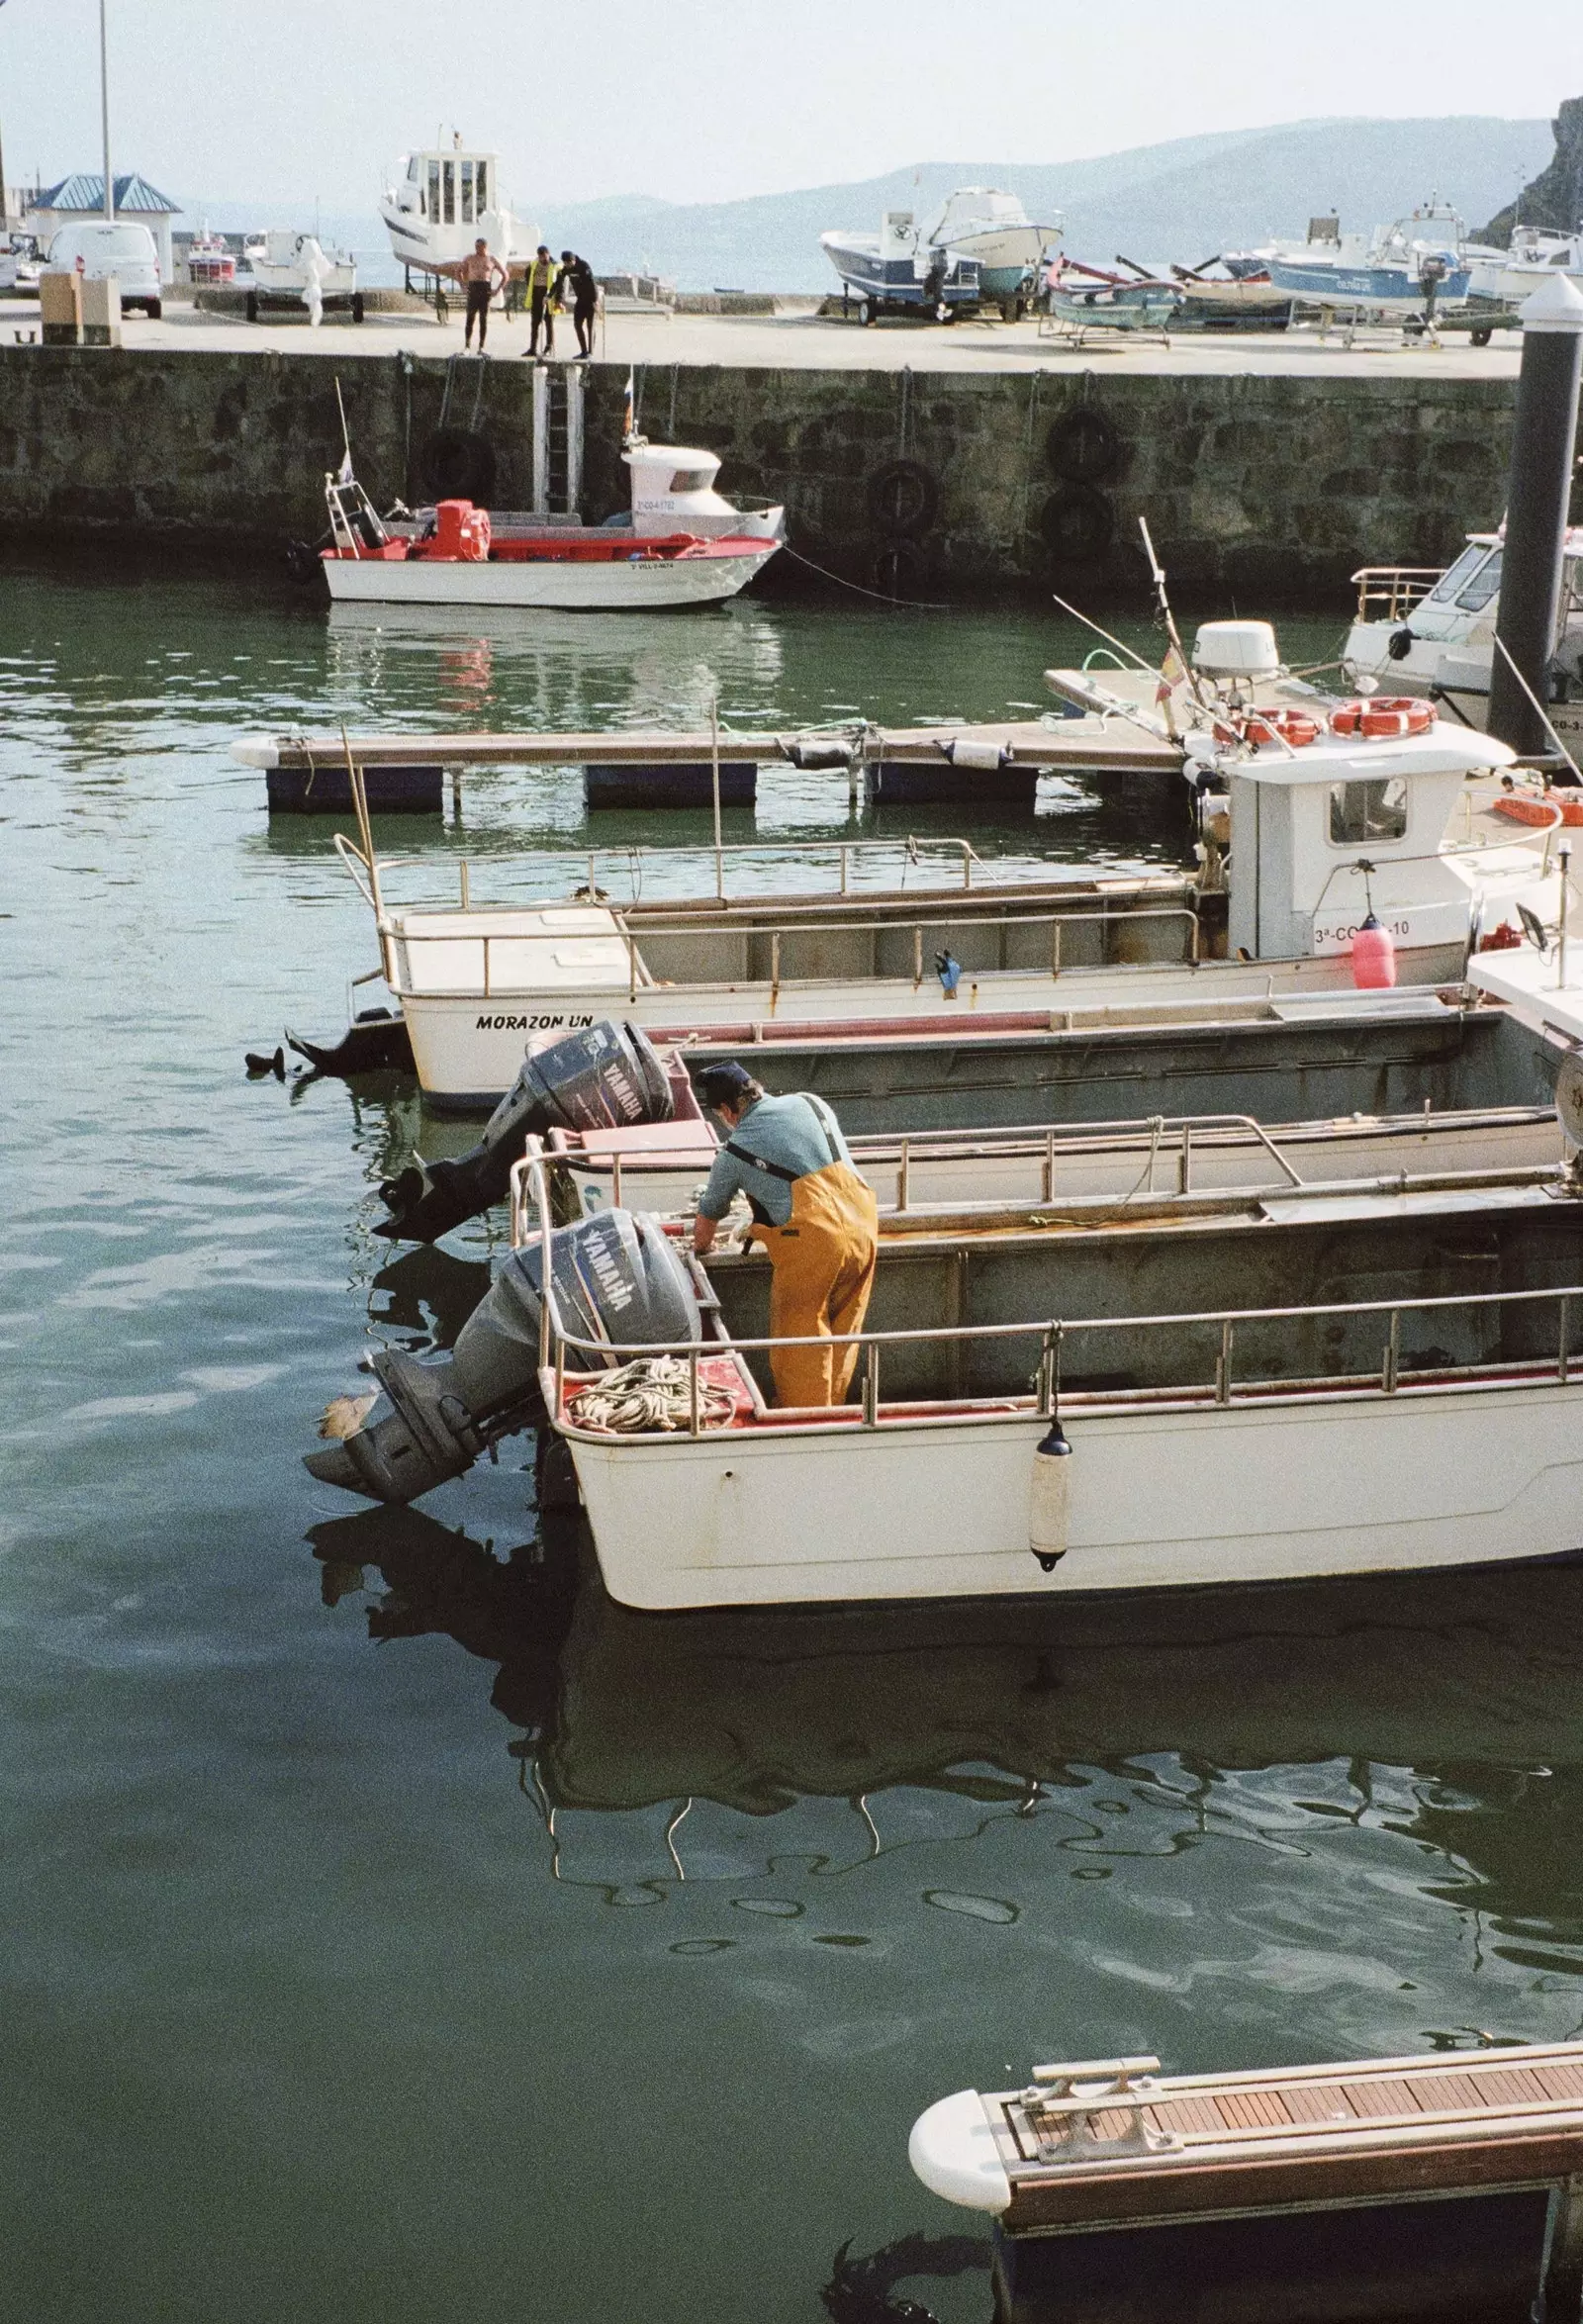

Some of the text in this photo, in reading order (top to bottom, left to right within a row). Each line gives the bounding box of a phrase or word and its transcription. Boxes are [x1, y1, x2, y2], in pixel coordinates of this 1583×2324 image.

[476, 1015, 593, 1029] MORAZON UN
[604, 1063, 643, 1120] YAMAHA
[582, 1230, 633, 1312] YAMAHA
